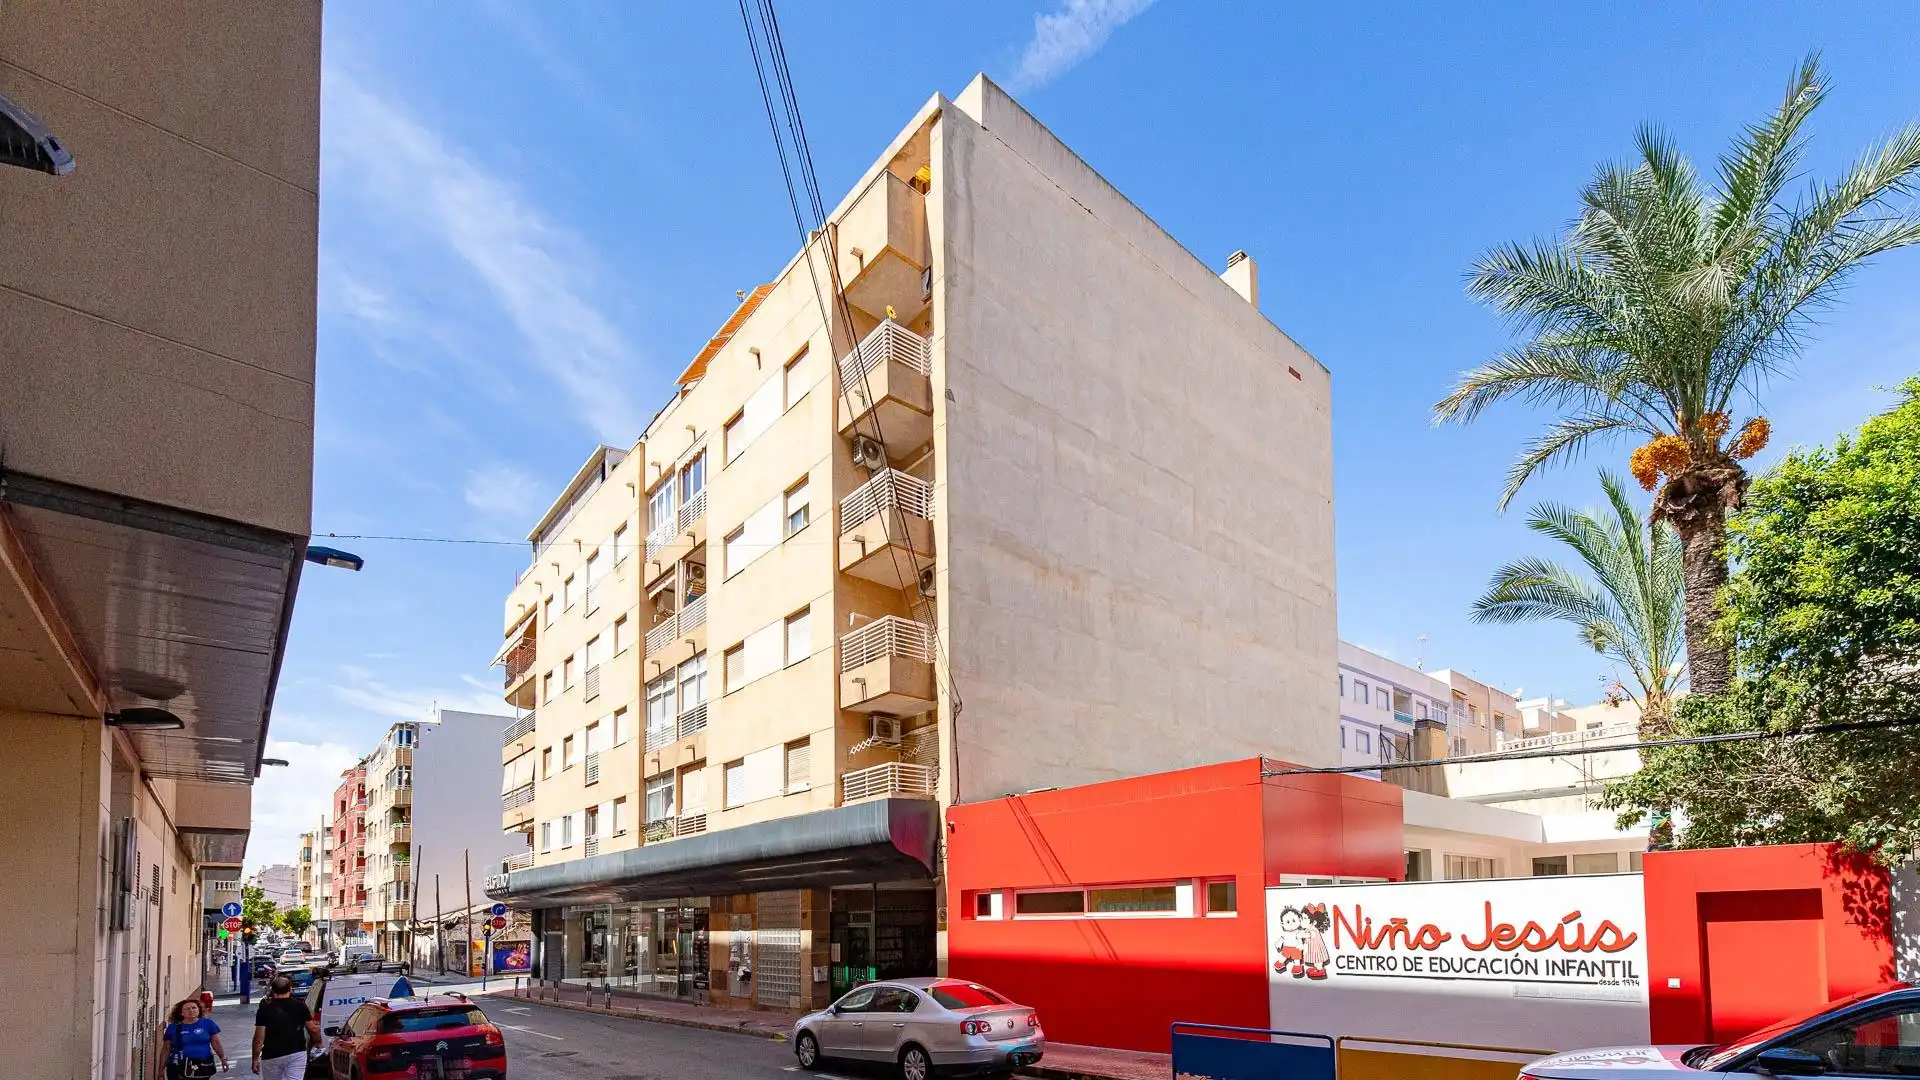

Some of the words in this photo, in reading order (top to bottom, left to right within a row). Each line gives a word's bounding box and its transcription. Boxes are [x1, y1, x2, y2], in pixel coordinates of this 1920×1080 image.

[1332, 904, 1452, 952] Niño
[1461, 900, 1638, 953] Jesús
[1336, 954, 1398, 972] CENTRO
[1403, 955, 1424, 972] DE
[1429, 953, 1539, 976] EDUCACIÓN
[1545, 958, 1639, 979] INFANTIL
[1599, 977, 1620, 986] desde
[1621, 979, 1640, 987] 1974
